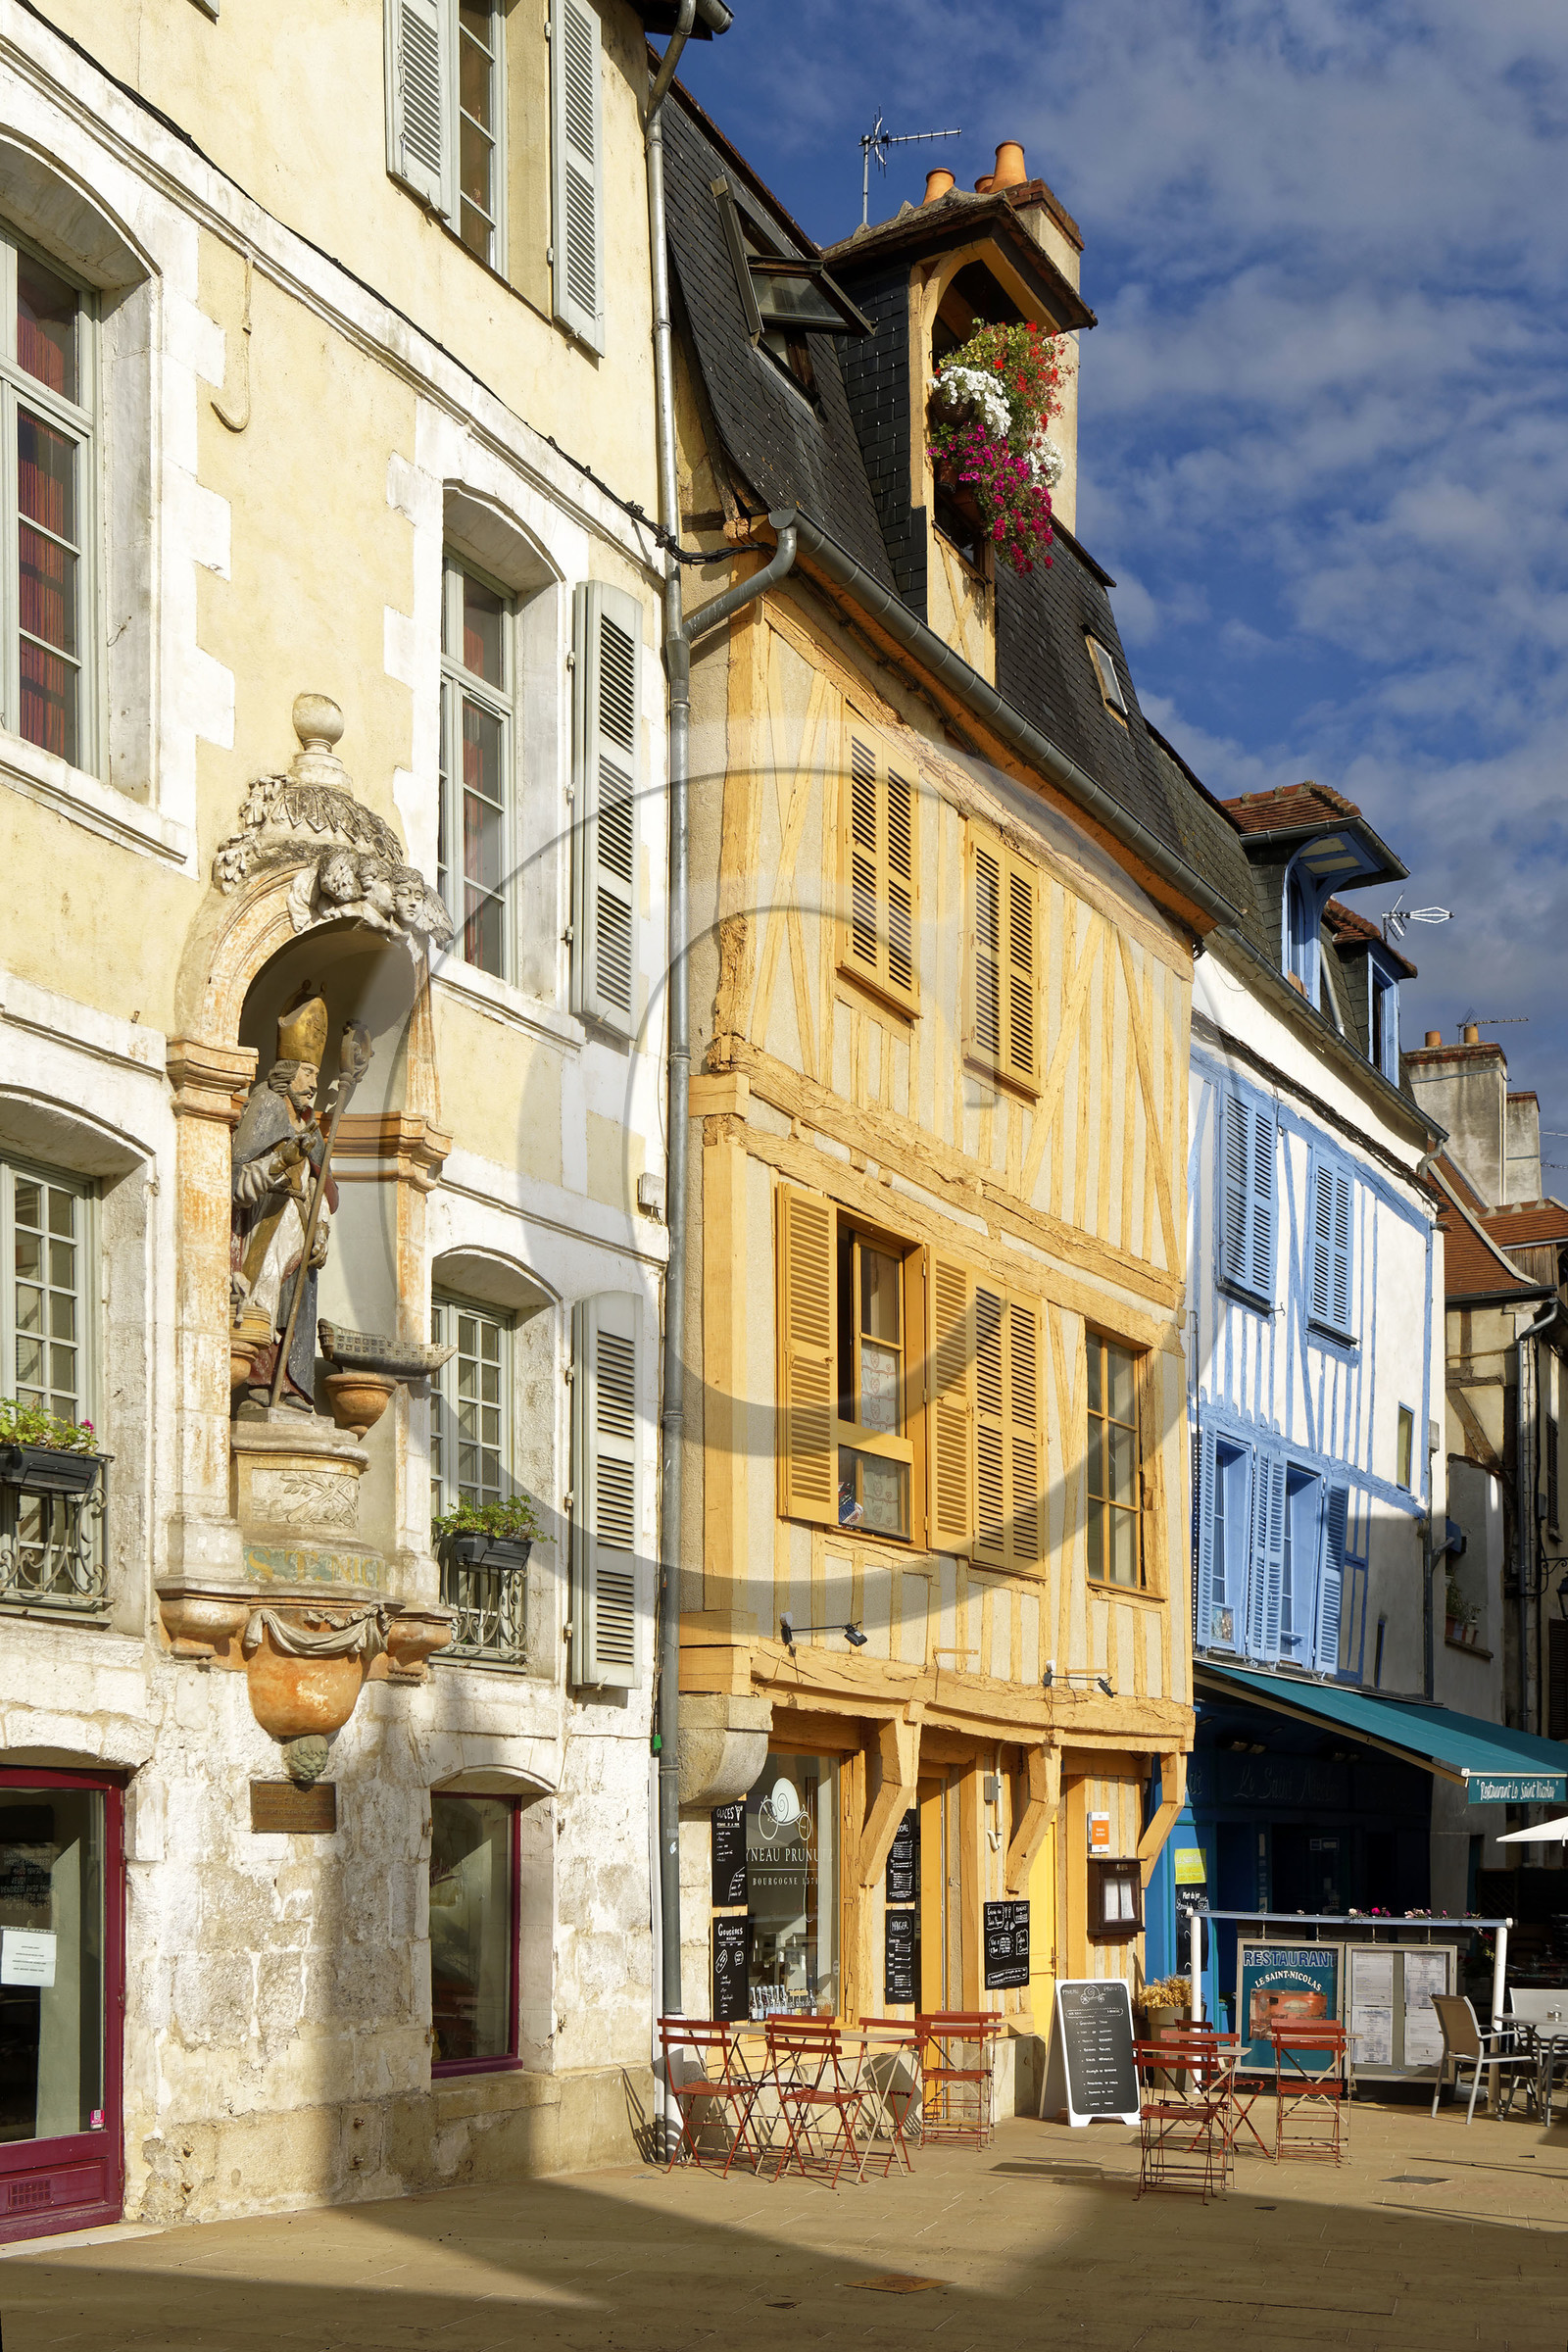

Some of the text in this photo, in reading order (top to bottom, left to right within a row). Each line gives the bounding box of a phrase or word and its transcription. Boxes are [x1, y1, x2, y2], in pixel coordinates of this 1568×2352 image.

[1520, 1782, 1536, 1799] Saint
[746, 1847, 780, 1862] YNEAU
[752, 1877, 798, 1886] BOURGOGNE
[1254, 1970, 1322, 1991] LE SAINT-NICOLAS
